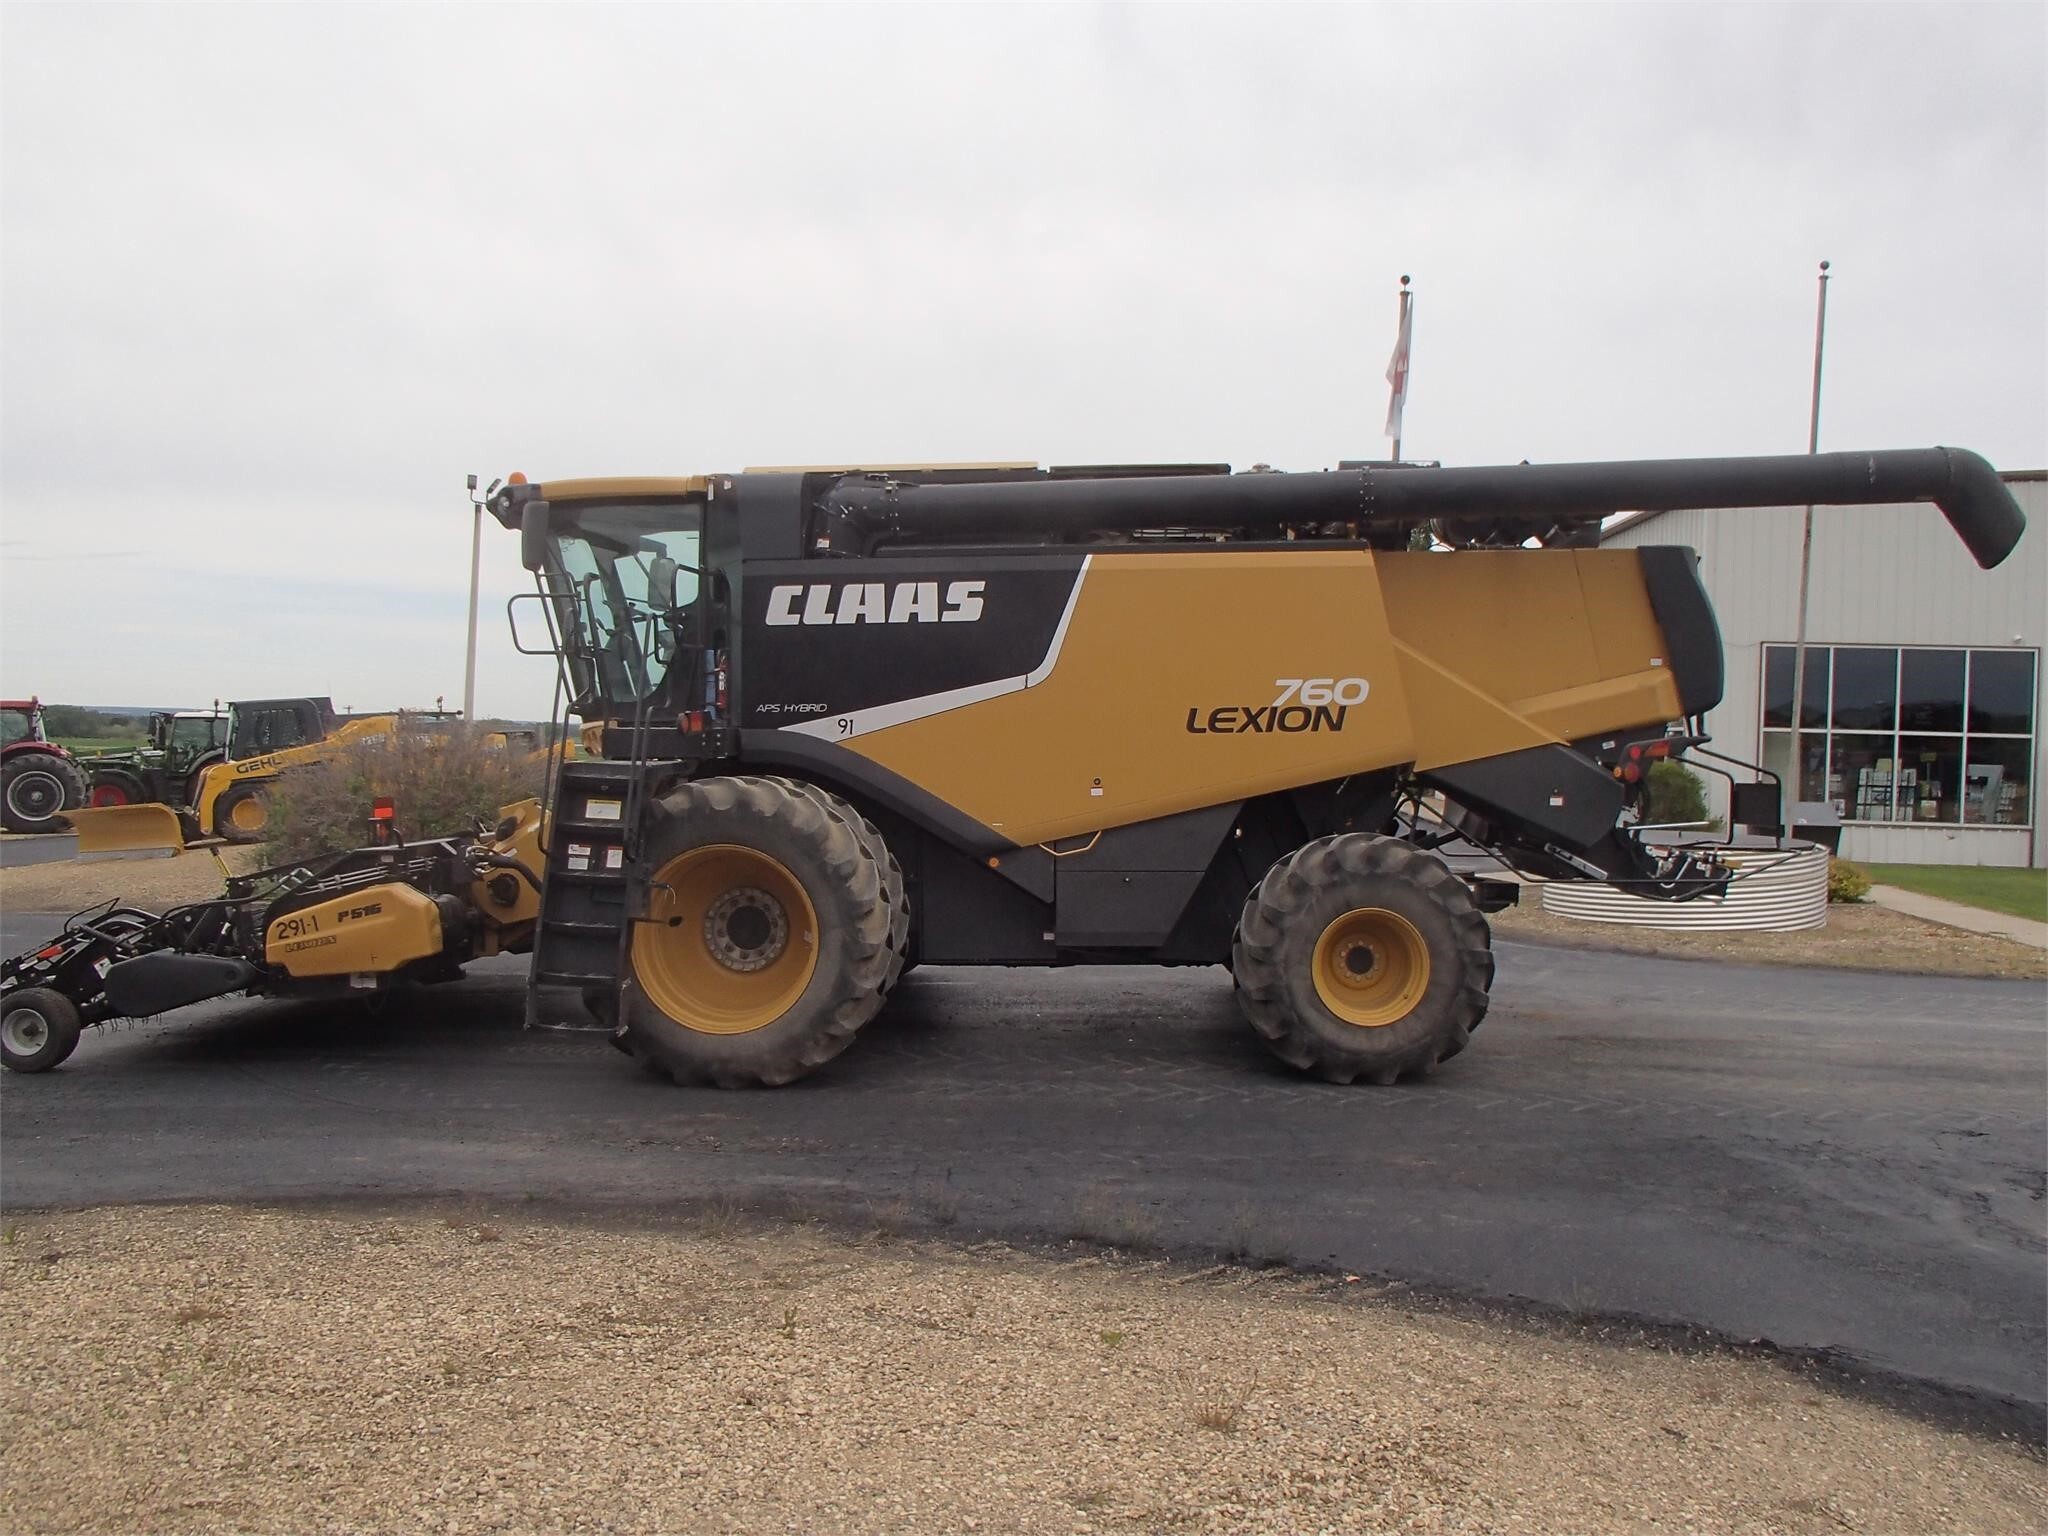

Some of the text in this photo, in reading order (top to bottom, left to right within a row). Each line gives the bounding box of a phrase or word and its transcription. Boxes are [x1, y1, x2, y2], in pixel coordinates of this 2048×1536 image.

[765, 581, 986, 626] CLAAS
[1271, 677, 1370, 707] 760
[756, 703, 828, 713] APS HYBRID
[1186, 705, 1347, 734] LEXION
[837, 718, 854, 735] 91
[235, 755, 283, 775] GEHL
[276, 914, 320, 940] 291-1
